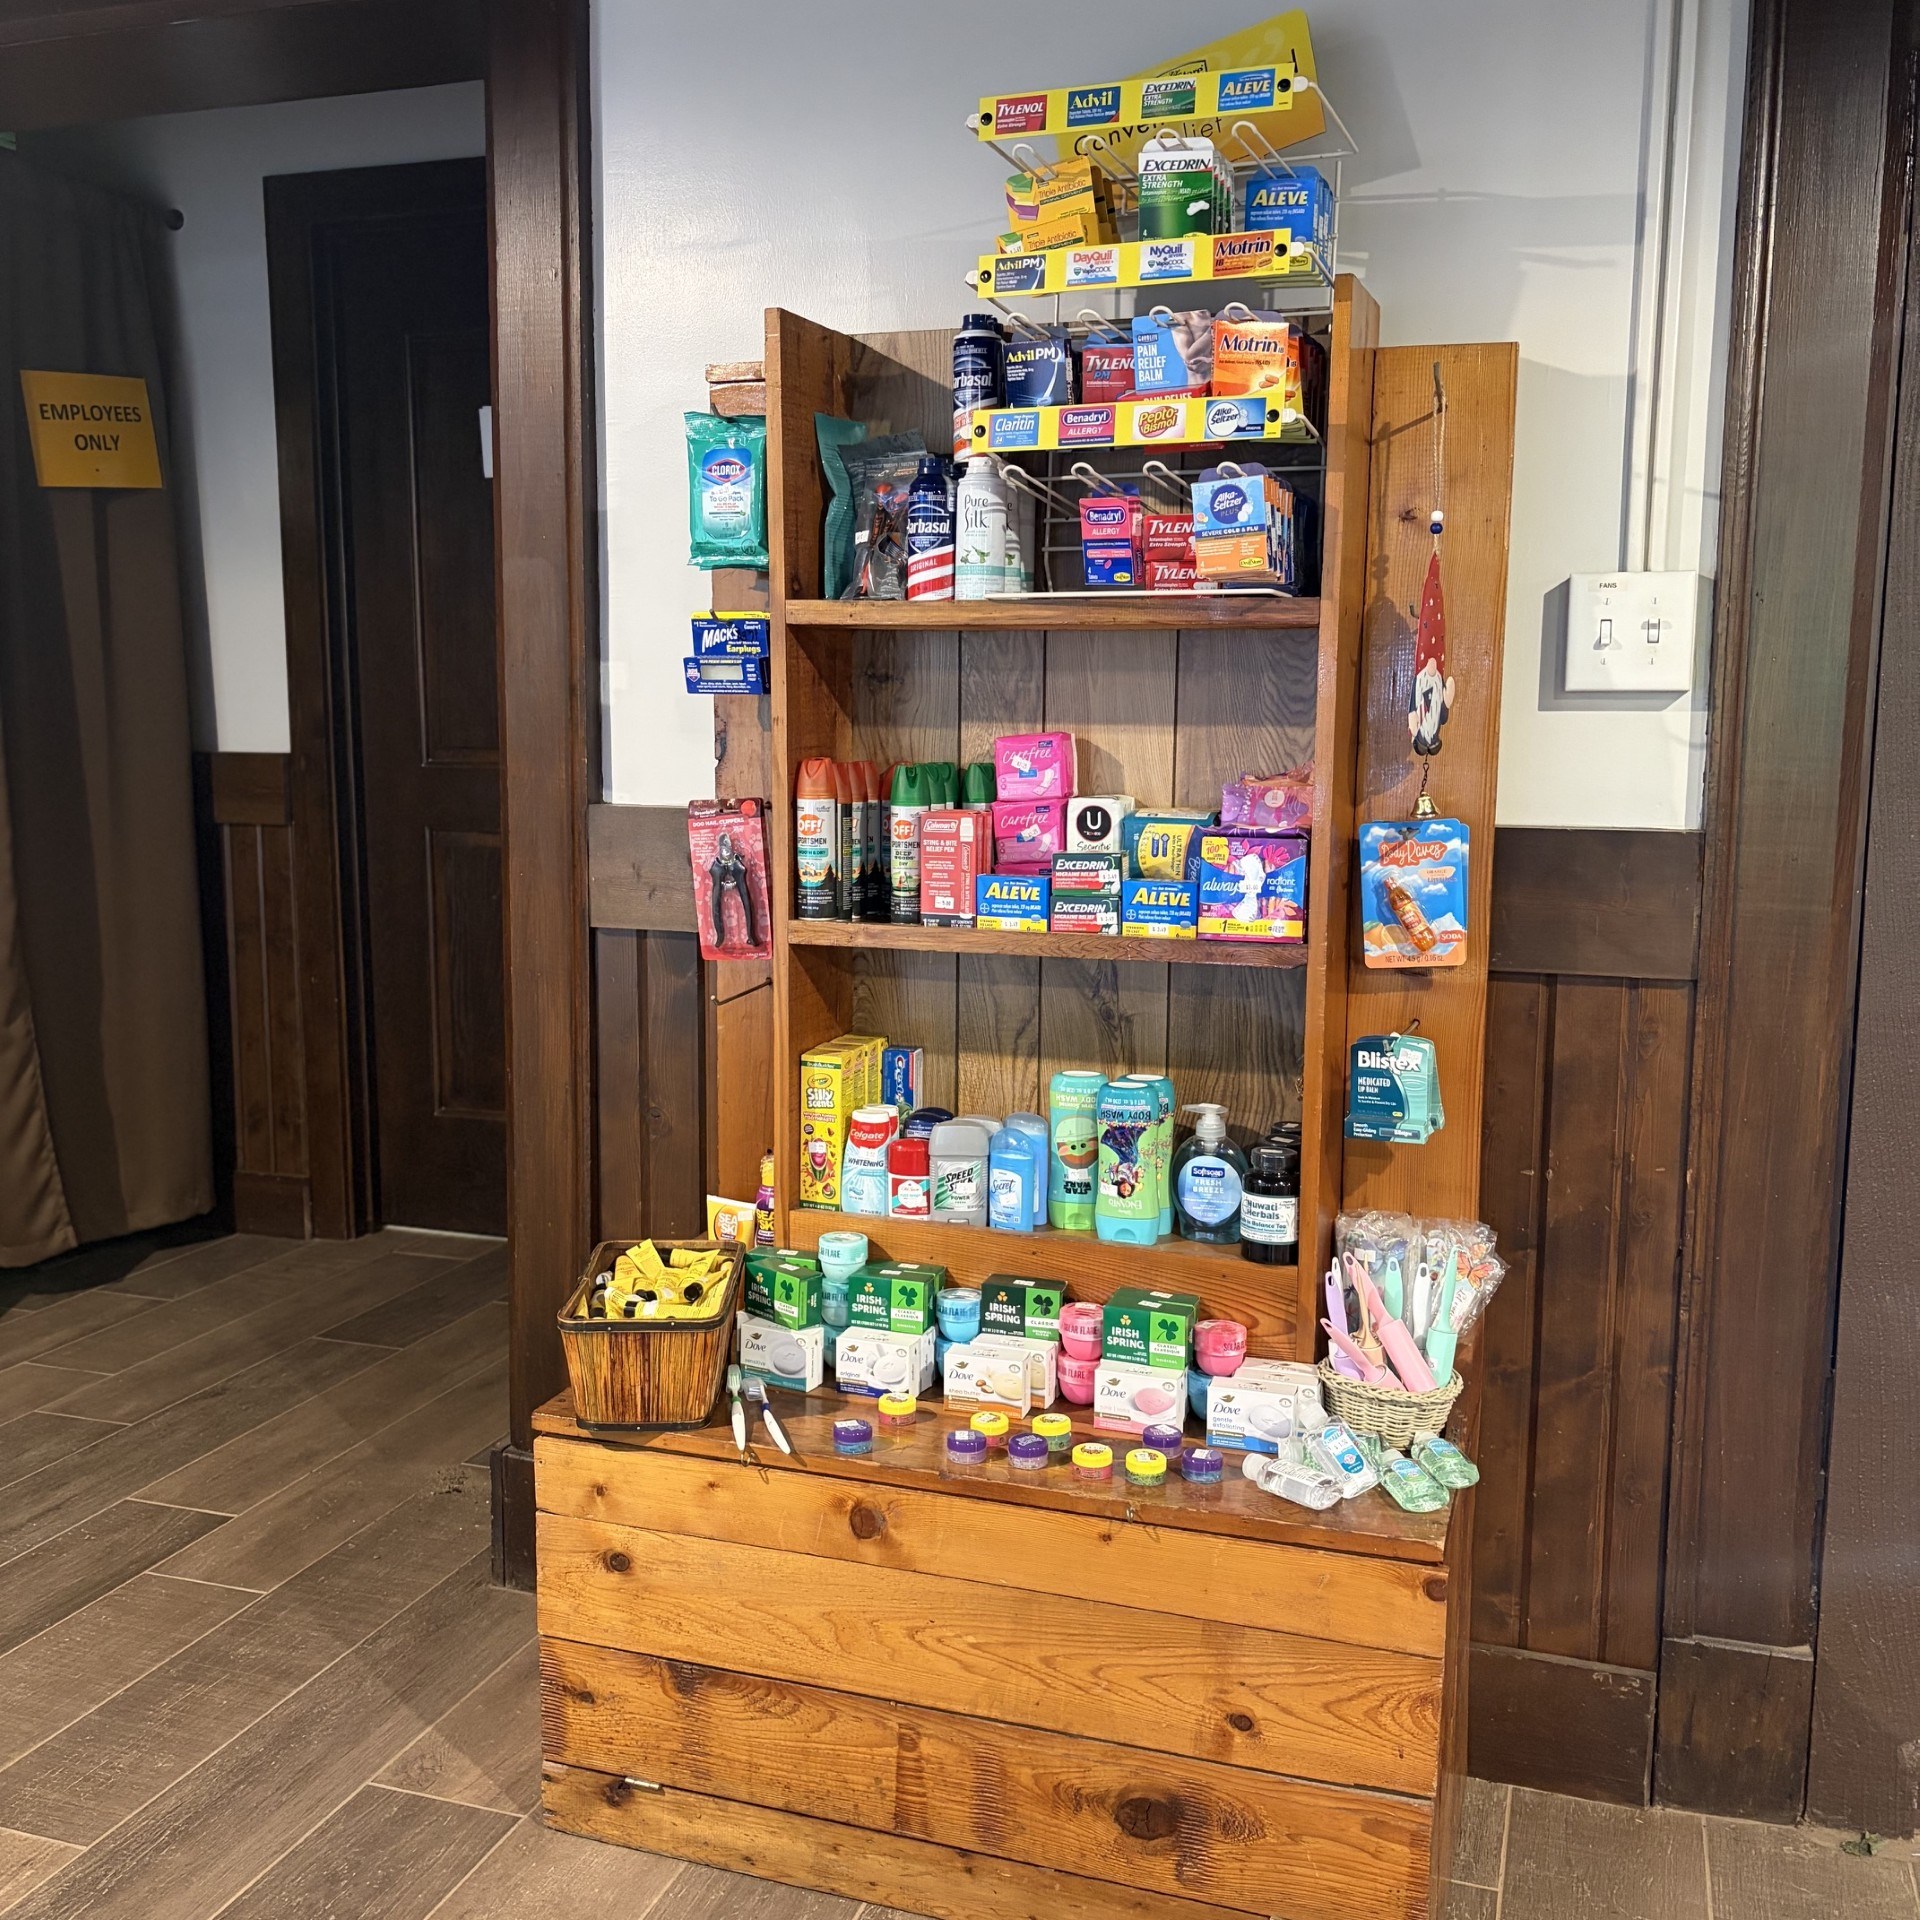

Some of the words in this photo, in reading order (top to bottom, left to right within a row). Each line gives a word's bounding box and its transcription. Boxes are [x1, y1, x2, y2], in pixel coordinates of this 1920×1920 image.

[1144, 80, 1196, 94] EXCEDRIN
[1221, 79, 1272, 97] ALEVE
[1070, 91, 1113, 110] Advil
[1143, 98, 1173, 107] STRENGTH
[997, 102, 1044, 118] TYLENOL
[1143, 158, 1211, 172] EXCEDRIN
[1142, 174, 1167, 182] EXTRA
[1142, 180, 1184, 189] STRENGTH
[1039, 188, 1057, 198] Triple
[1057, 179, 1087, 195] Antibiotic
[1252, 189, 1309, 207] ALEVE
[1028, 239, 1046, 250] Triple
[1046, 230, 1078, 244] Antibiotic
[1215, 236, 1272, 257] Motrin
[1150, 243, 1183, 258] NyQuil
[1073, 250, 1113, 265] DayQuil
[1220, 334, 1278, 353] Motrin
[1137, 344, 1158, 358] PAIN
[1138, 356, 1167, 370] RELIEF
[1093, 371, 1111, 380] PM
[1138, 369, 1163, 383] BALM
[39, 403, 142, 423] EMPLOYEES
[1066, 412, 1107, 424] Benadryl
[1139, 408, 1179, 425] Pepto-
[1210, 413, 1240, 425] Seltzer
[995, 417, 1035, 432] Claritin
[1142, 416, 1176, 435] Bismol
[1067, 427, 1103, 436] ALLERGY
[74, 434, 120, 451] ONLY
[711, 465, 741, 476] CLOROX
[709, 495, 718, 503] To
[728, 495, 744, 503] Pack
[964, 494, 989, 510] Pure
[1213, 496, 1244, 512] Seltzer
[1089, 511, 1122, 523] Benadryl
[1220, 507, 1240, 517] PLUS
[964, 508, 989, 533] Silk
[1092, 527, 1120, 536] ALLERGY
[1201, 529, 1222, 537] SEVERE
[1223, 527, 1240, 535] COLD
[1164, 541, 1187, 549] Strength
[910, 558, 938, 572] ORIGINAL
[701, 623, 739, 654] MACK'S
[726, 644, 762, 655] Earplugs
[719, 817, 745, 825] CLIPPERS
[798, 818, 824, 833] OFF!
[1000, 812, 1049, 829] carefree
[1086, 811, 1102, 830] U
[893, 824, 916, 837] OFF!
[945, 839, 958, 847] BITE
[1076, 841, 1111, 852] Security
[1381, 843, 1407, 864] Body
[1404, 838, 1445, 863] Raves
[1055, 859, 1109, 871] EXCEDRIN
[1202, 877, 1241, 896] always
[1266, 876, 1296, 886] radiant
[985, 882, 1040, 901] ALEVE
[1131, 887, 1191, 907] ALEVE
[1054, 901, 1106, 914] EXCEDRIN
[1357, 1050, 1420, 1076] Blistex
[1357, 1076, 1391, 1088] MEDICATED
[806, 1087, 834, 1100] Silly
[1366, 1086, 1379, 1094] BALM
[1101, 1110, 1124, 1120] WASH
[1127, 1110, 1151, 1121] BODY
[850, 1128, 885, 1141] Colgate
[848, 1157, 884, 1168] WHITENING
[945, 1167, 974, 1184] SPEED
[1193, 1168, 1224, 1177] Softsoap
[992, 1178, 1016, 1195] Secret
[1063, 1181, 1092, 1190] WARS
[1064, 1187, 1088, 1195] STAR
[1193, 1186, 1224, 1194] BREEZE
[1108, 1198, 1142, 1210] ENCANTO
[718, 1212, 737, 1226] SEA
[1247, 1209, 1280, 1220] Herbals
[720, 1222, 737, 1236] SKI
[751, 1282, 769, 1296] IRISH
[748, 1291, 772, 1307] SPRING
[856, 1294, 882, 1306] IRISH
[852, 1303, 888, 1316] SPRING
[989, 1302, 1016, 1314] IRISH
[985, 1312, 1021, 1325] SPRING
[1111, 1326, 1140, 1339] IRISH
[744, 1339, 767, 1352] Dove
[1106, 1337, 1146, 1350] SPRING
[840, 1351, 864, 1365] Dove
[840, 1371, 861, 1379] original
[949, 1368, 974, 1381] Dove
[1067, 1368, 1085, 1379] FLARE
[949, 1388, 963, 1396] shea
[963, 1389, 981, 1397] butter
[1100, 1384, 1127, 1399] Dove
[1212, 1402, 1241, 1415] Dove
[1212, 1416, 1232, 1424] gentle
[1212, 1422, 1245, 1433] exfoliating
